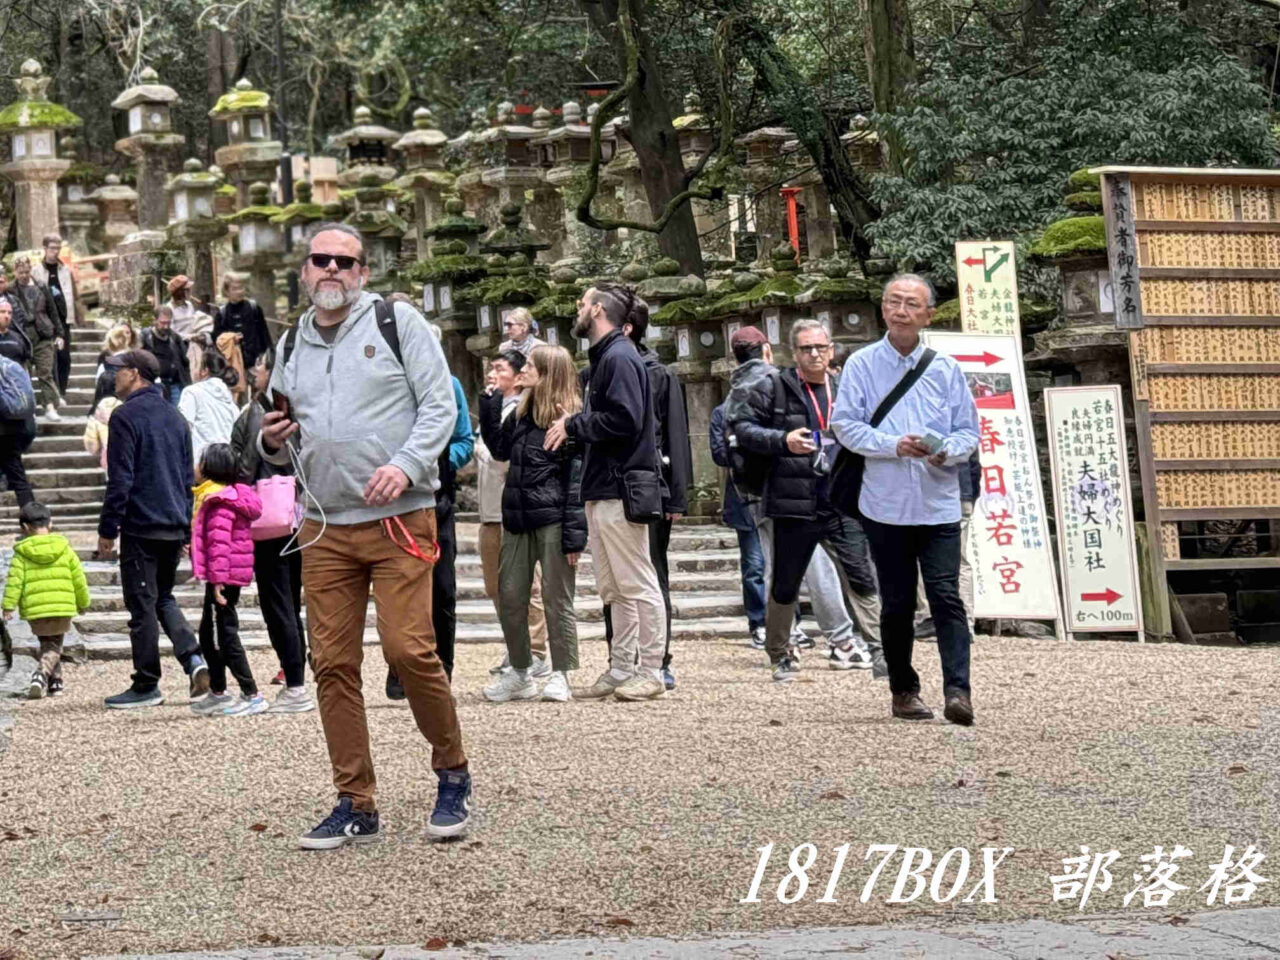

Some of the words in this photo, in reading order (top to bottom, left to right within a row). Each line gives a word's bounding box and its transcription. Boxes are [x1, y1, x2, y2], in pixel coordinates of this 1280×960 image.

[964, 283, 978, 330] 春日大社
[1071, 408, 1084, 456] 良縁成就
[1082, 408, 1095, 456] 夫婦円満
[1092, 399, 1112, 531] 若宮十五社めぐり
[1104, 398, 1123, 538] 春日五大龍神めぐり
[979, 416, 1024, 594] 春日若宮
[1077, 460, 1106, 573] 夫婦大国社
[1076, 610, 1133, 623] 右へ100m
